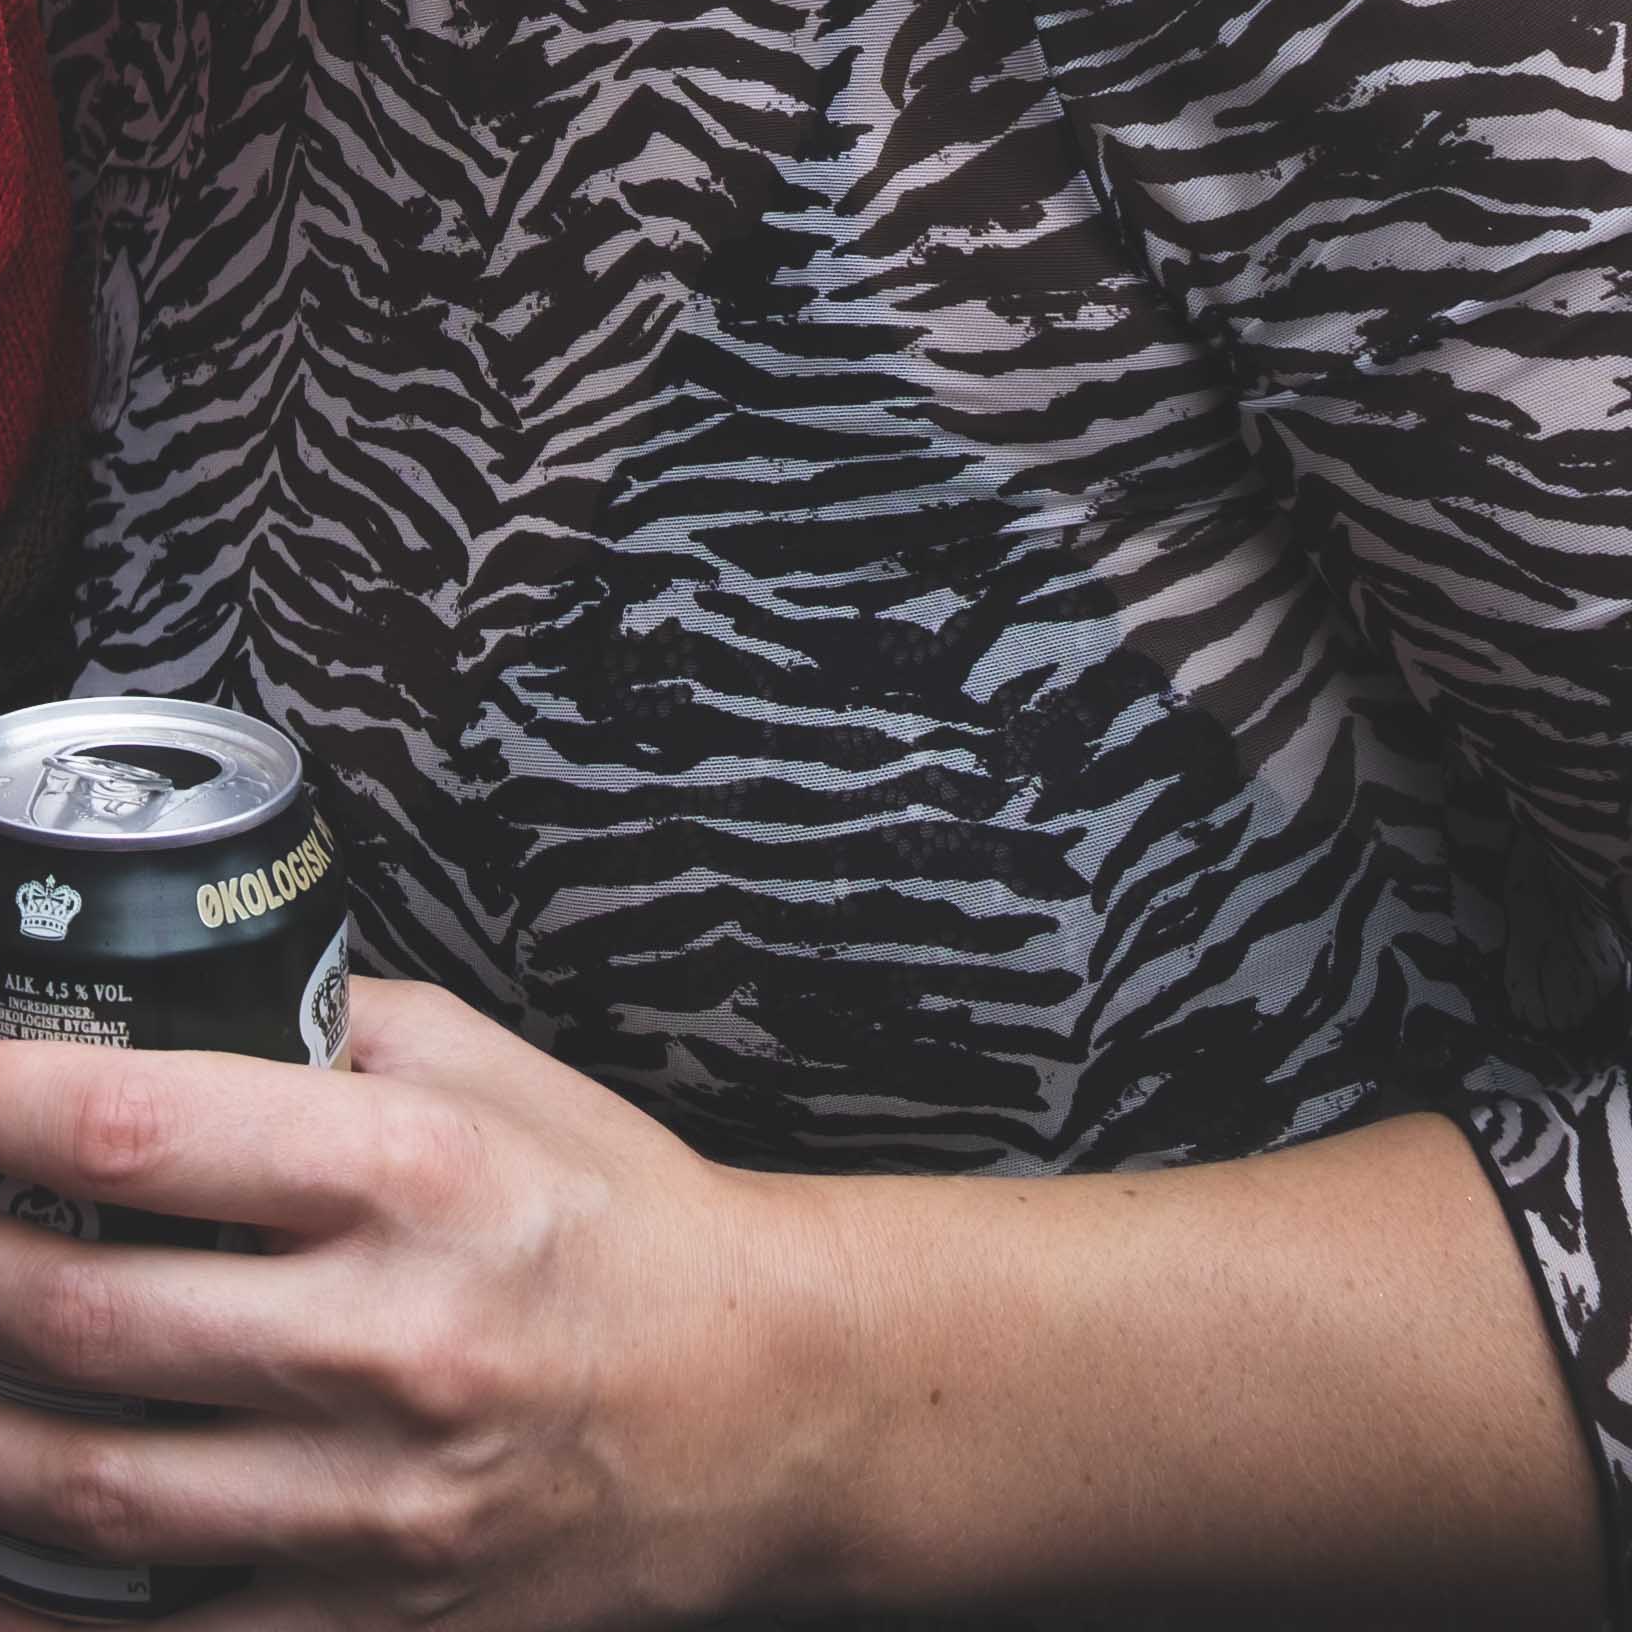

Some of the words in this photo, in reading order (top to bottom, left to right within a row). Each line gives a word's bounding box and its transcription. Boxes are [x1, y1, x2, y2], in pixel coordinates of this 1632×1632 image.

[197, 828, 332, 928] ØKOLOGISK
[5, 974, 40, 994] ALK.
[45, 981, 68, 1000] 4,5
[74, 984, 88, 1001] %
[94, 985, 133, 1002] VOL.
[8, 996, 95, 1019] INGREDIENSER:
[64, 1019, 130, 1035] BYGMALT,
